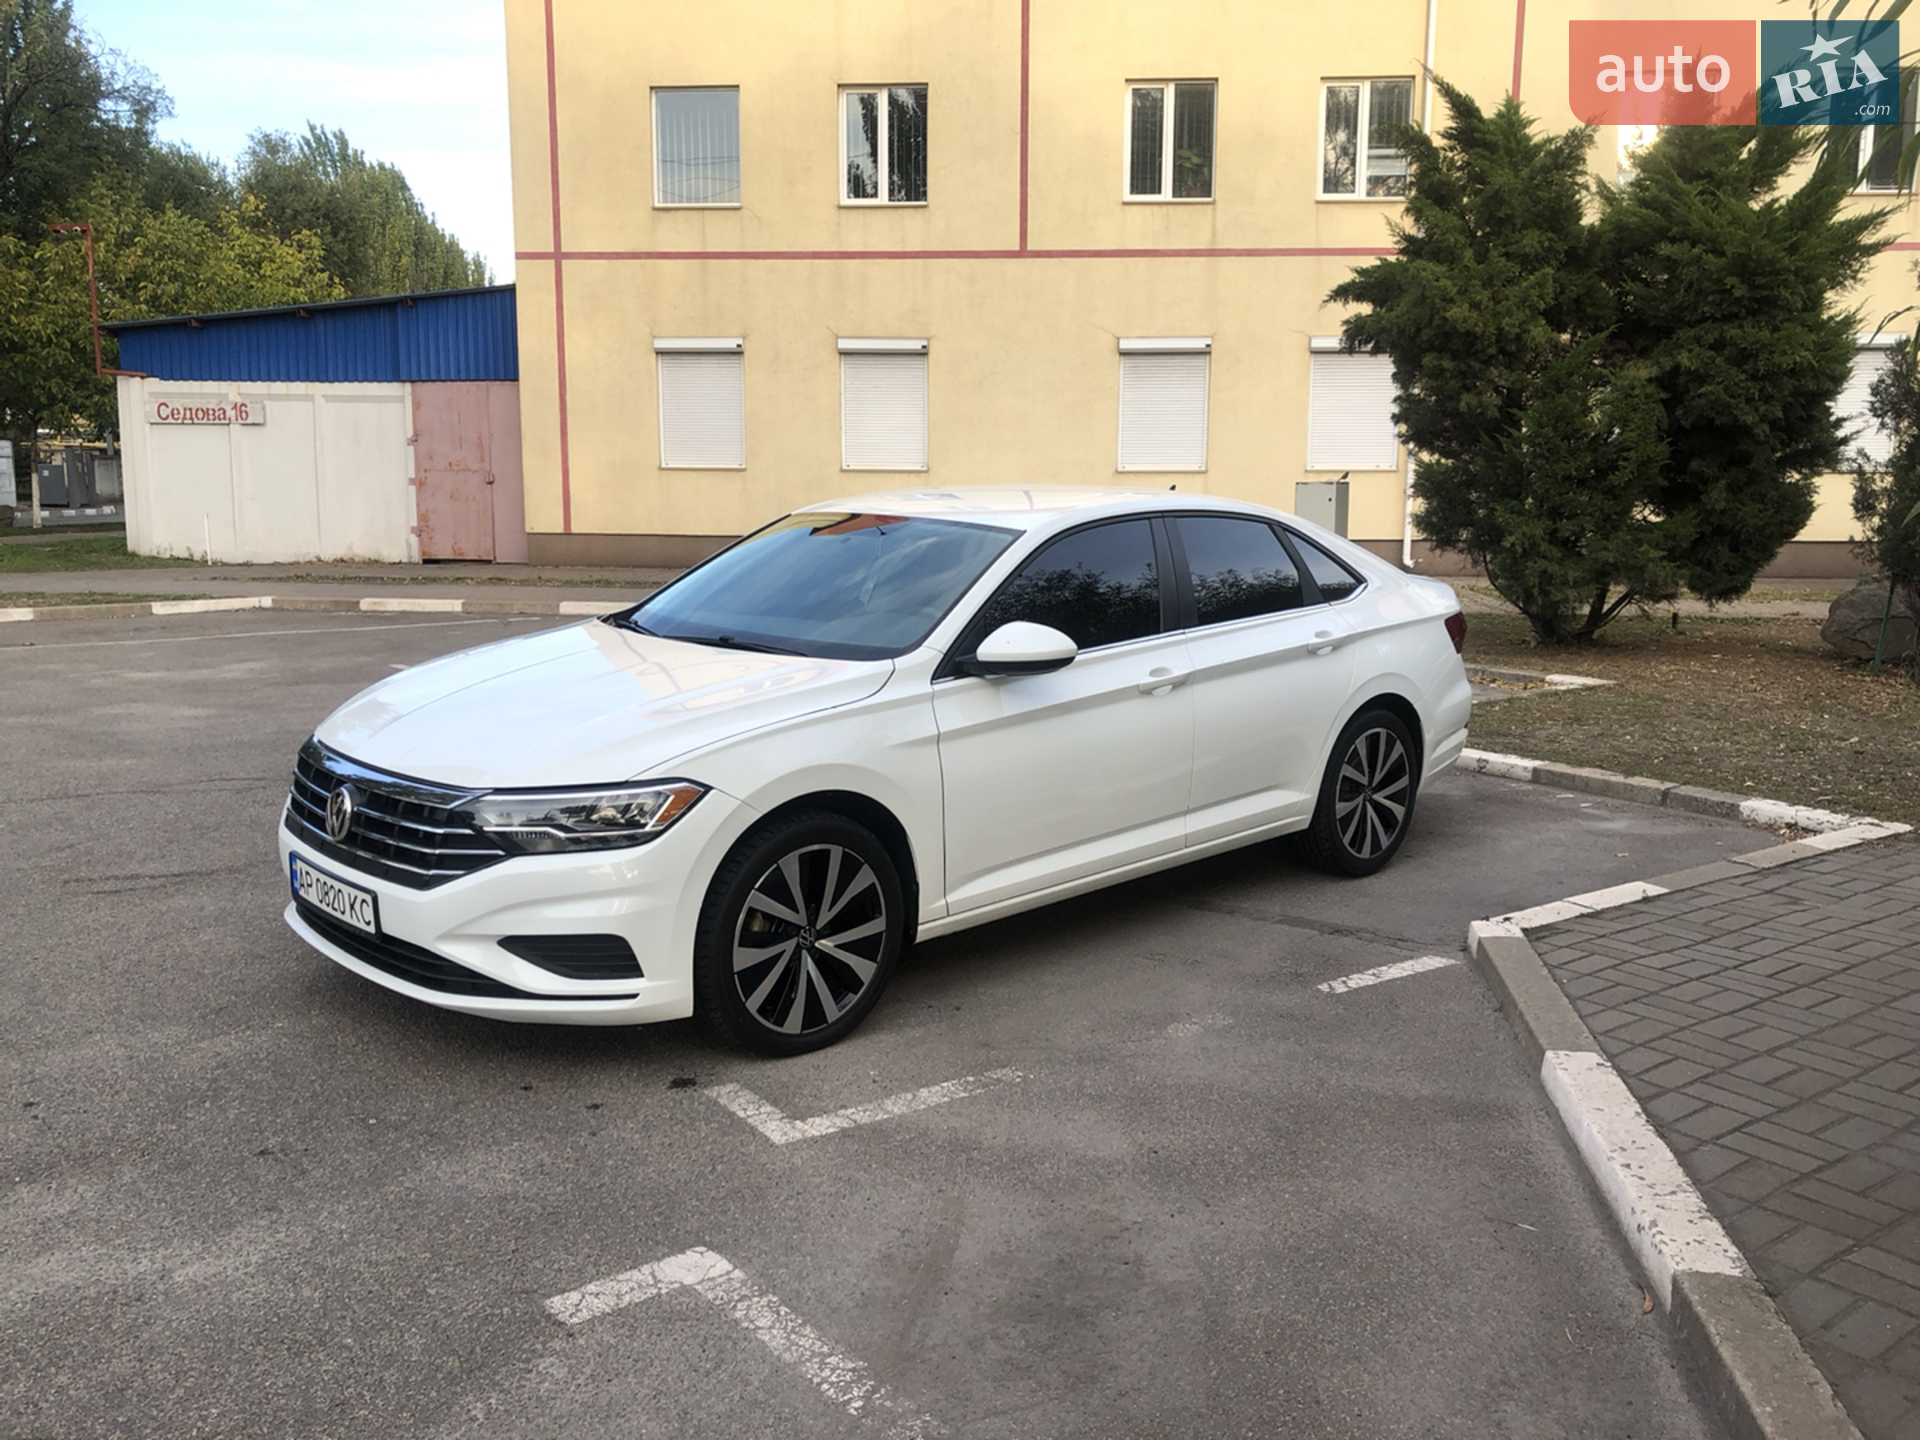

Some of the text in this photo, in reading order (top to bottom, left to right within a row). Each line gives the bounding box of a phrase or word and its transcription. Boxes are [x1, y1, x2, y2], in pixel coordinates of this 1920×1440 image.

[299, 867, 372, 926] AP 0820 KC
